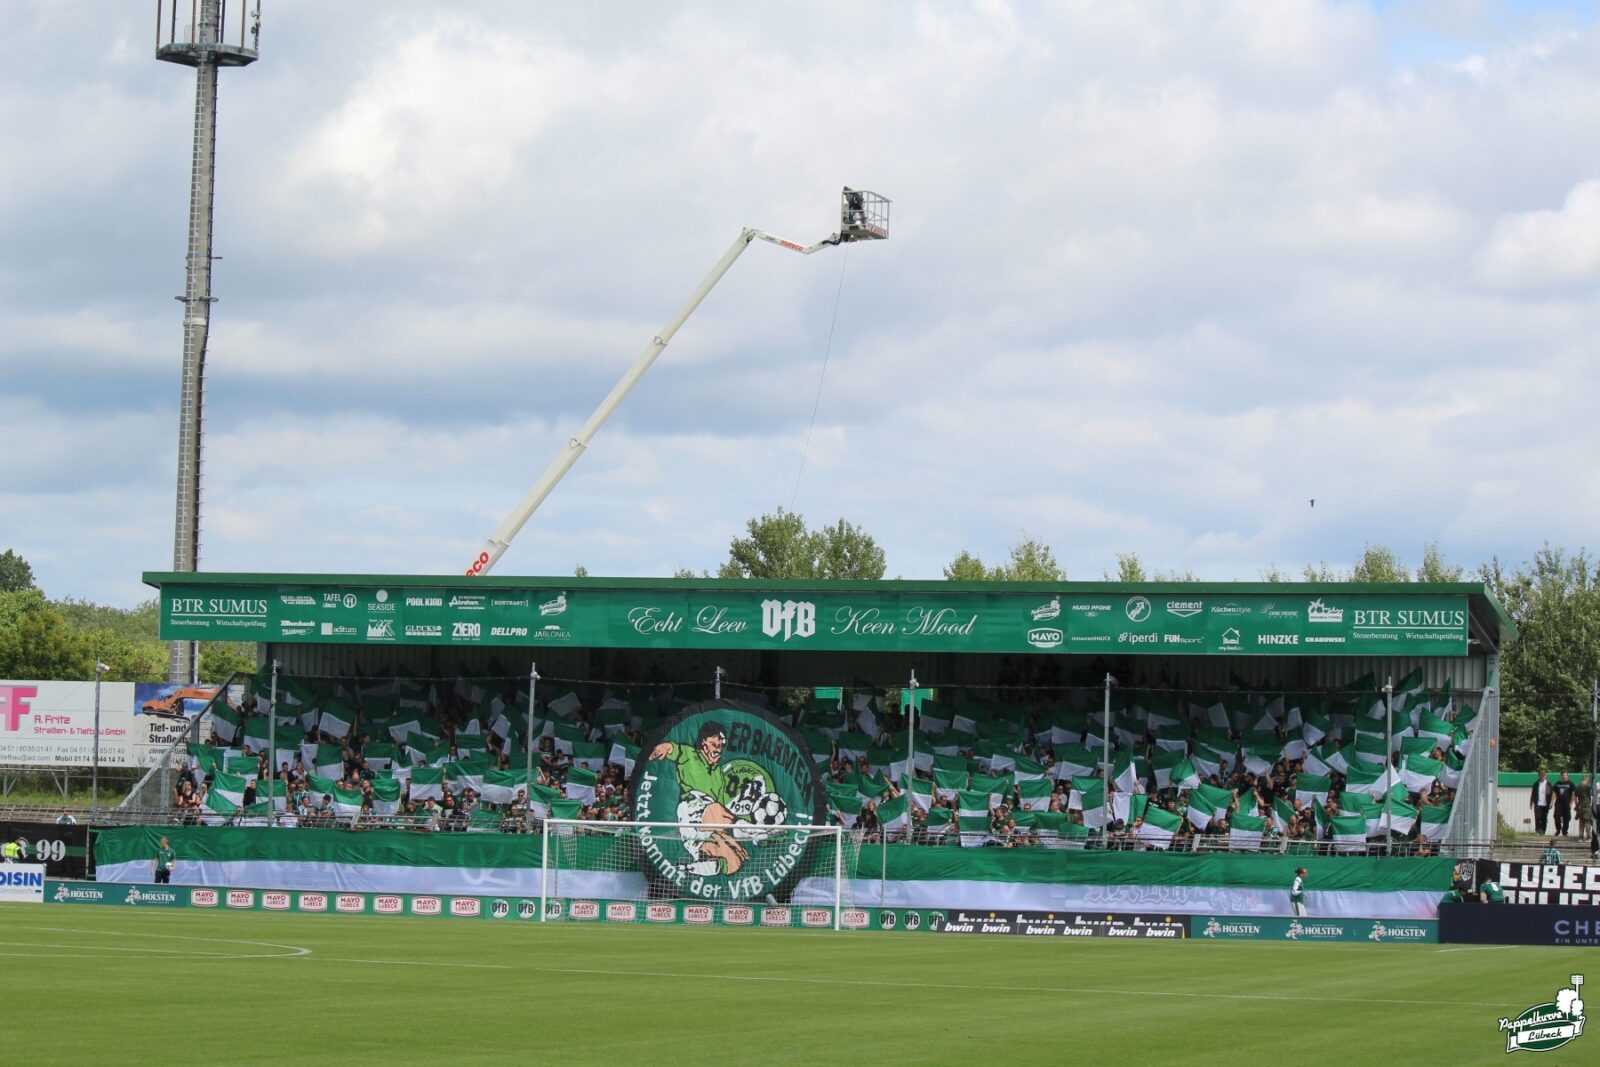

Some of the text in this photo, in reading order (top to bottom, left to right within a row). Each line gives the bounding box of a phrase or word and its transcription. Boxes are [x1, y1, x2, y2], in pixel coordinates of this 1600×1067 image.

[171, 599, 204, 612] BTR
[209, 600, 267, 614] SUMUS
[1167, 601, 1202, 609] clement
[628, 607, 683, 634] Echt
[830, 606, 978, 636] Keen Mood
[1354, 610, 1464, 626] BTR SUMUS
[216, 620, 267, 628] Wirtschaftsprüfung
[490, 627, 528, 636] DELLPRO
[1031, 632, 1060, 640] MAYO
[1353, 631, 1464, 642] Steuerberatung Wirtschaftsprüfung
[1129, 632, 1158, 644] iperdi
[1258, 635, 1298, 644] HINZKE
[45, 716, 70, 724] Fritz
[636, 771, 658, 818] Jetzt
[690, 877, 721, 899] der
[728, 876, 764, 900] VfB
[36, 839, 66, 862] 99
[70, 890, 104, 899] HOLSTEN
[142, 893, 175, 902] HOLSTEN
[944, 922, 974, 932] bwin
[982, 923, 1010, 933] bwin
[1026, 925, 1055, 934] bwin
[1063, 926, 1092, 936] bwin
[1108, 926, 1138, 936] bwin
[1146, 927, 1176, 937] bwin
[1222, 925, 1260, 934] HOLSTEN
[1305, 927, 1342, 936] HOLSTEN
[1388, 929, 1426, 938] HOLSTEN
